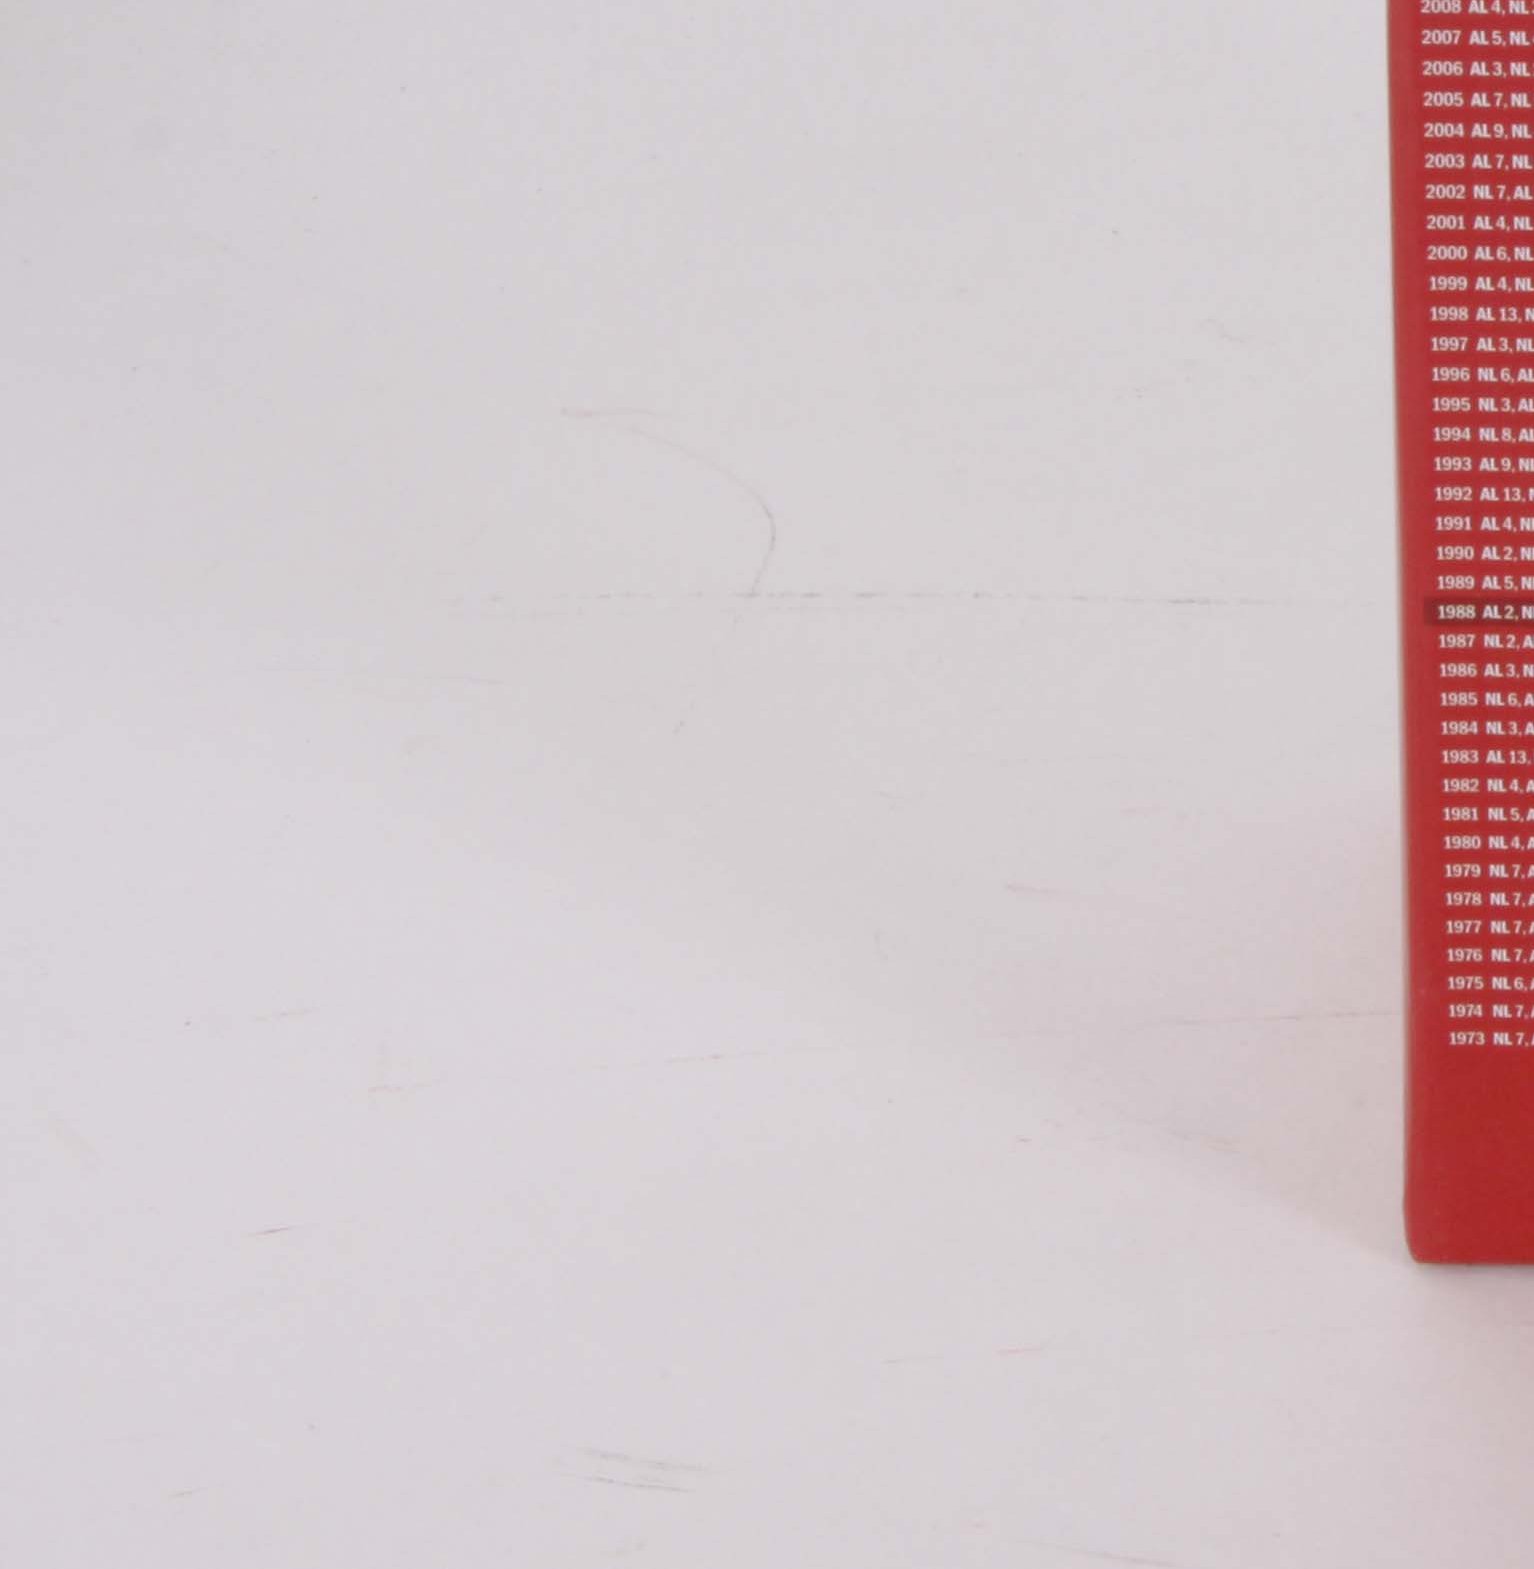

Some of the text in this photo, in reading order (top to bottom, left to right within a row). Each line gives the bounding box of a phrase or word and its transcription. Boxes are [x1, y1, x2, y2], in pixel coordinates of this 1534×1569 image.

[1421, 60, 1465, 77] 2006
[1424, 152, 1466, 170] 2003
[1429, 275, 1469, 292] 1999
[1431, 366, 1471, 382] 1996
[1435, 515, 1473, 532] 1991
[1437, 604, 1477, 620] 1988
[1441, 749, 1480, 765] 1983
[1449, 1030, 1486, 1046] 1973
